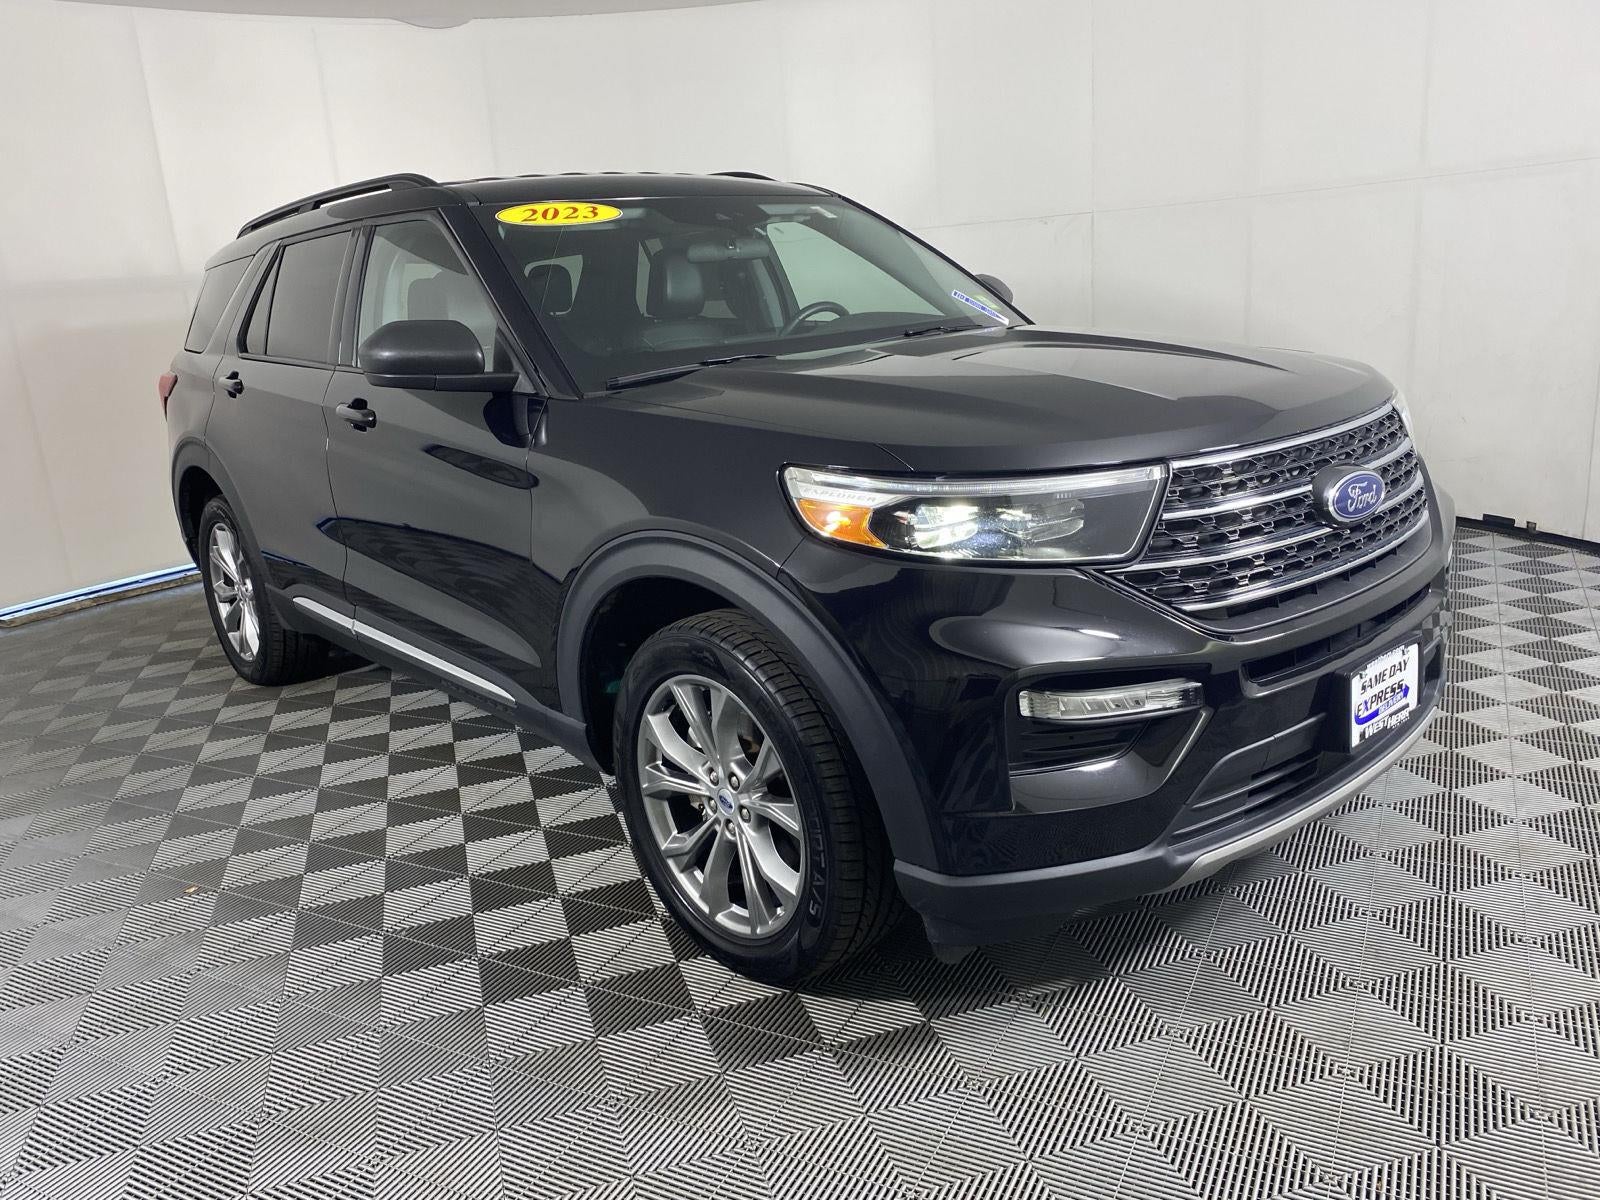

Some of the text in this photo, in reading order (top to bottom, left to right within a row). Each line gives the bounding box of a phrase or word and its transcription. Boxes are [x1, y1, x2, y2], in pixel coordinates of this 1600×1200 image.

[521, 206, 599, 222] 2023
[1347, 481, 1378, 512] Ford
[1361, 668, 1388, 695] SAME
[1389, 657, 1410, 679] DAY
[1357, 679, 1405, 717] EXPRESS
